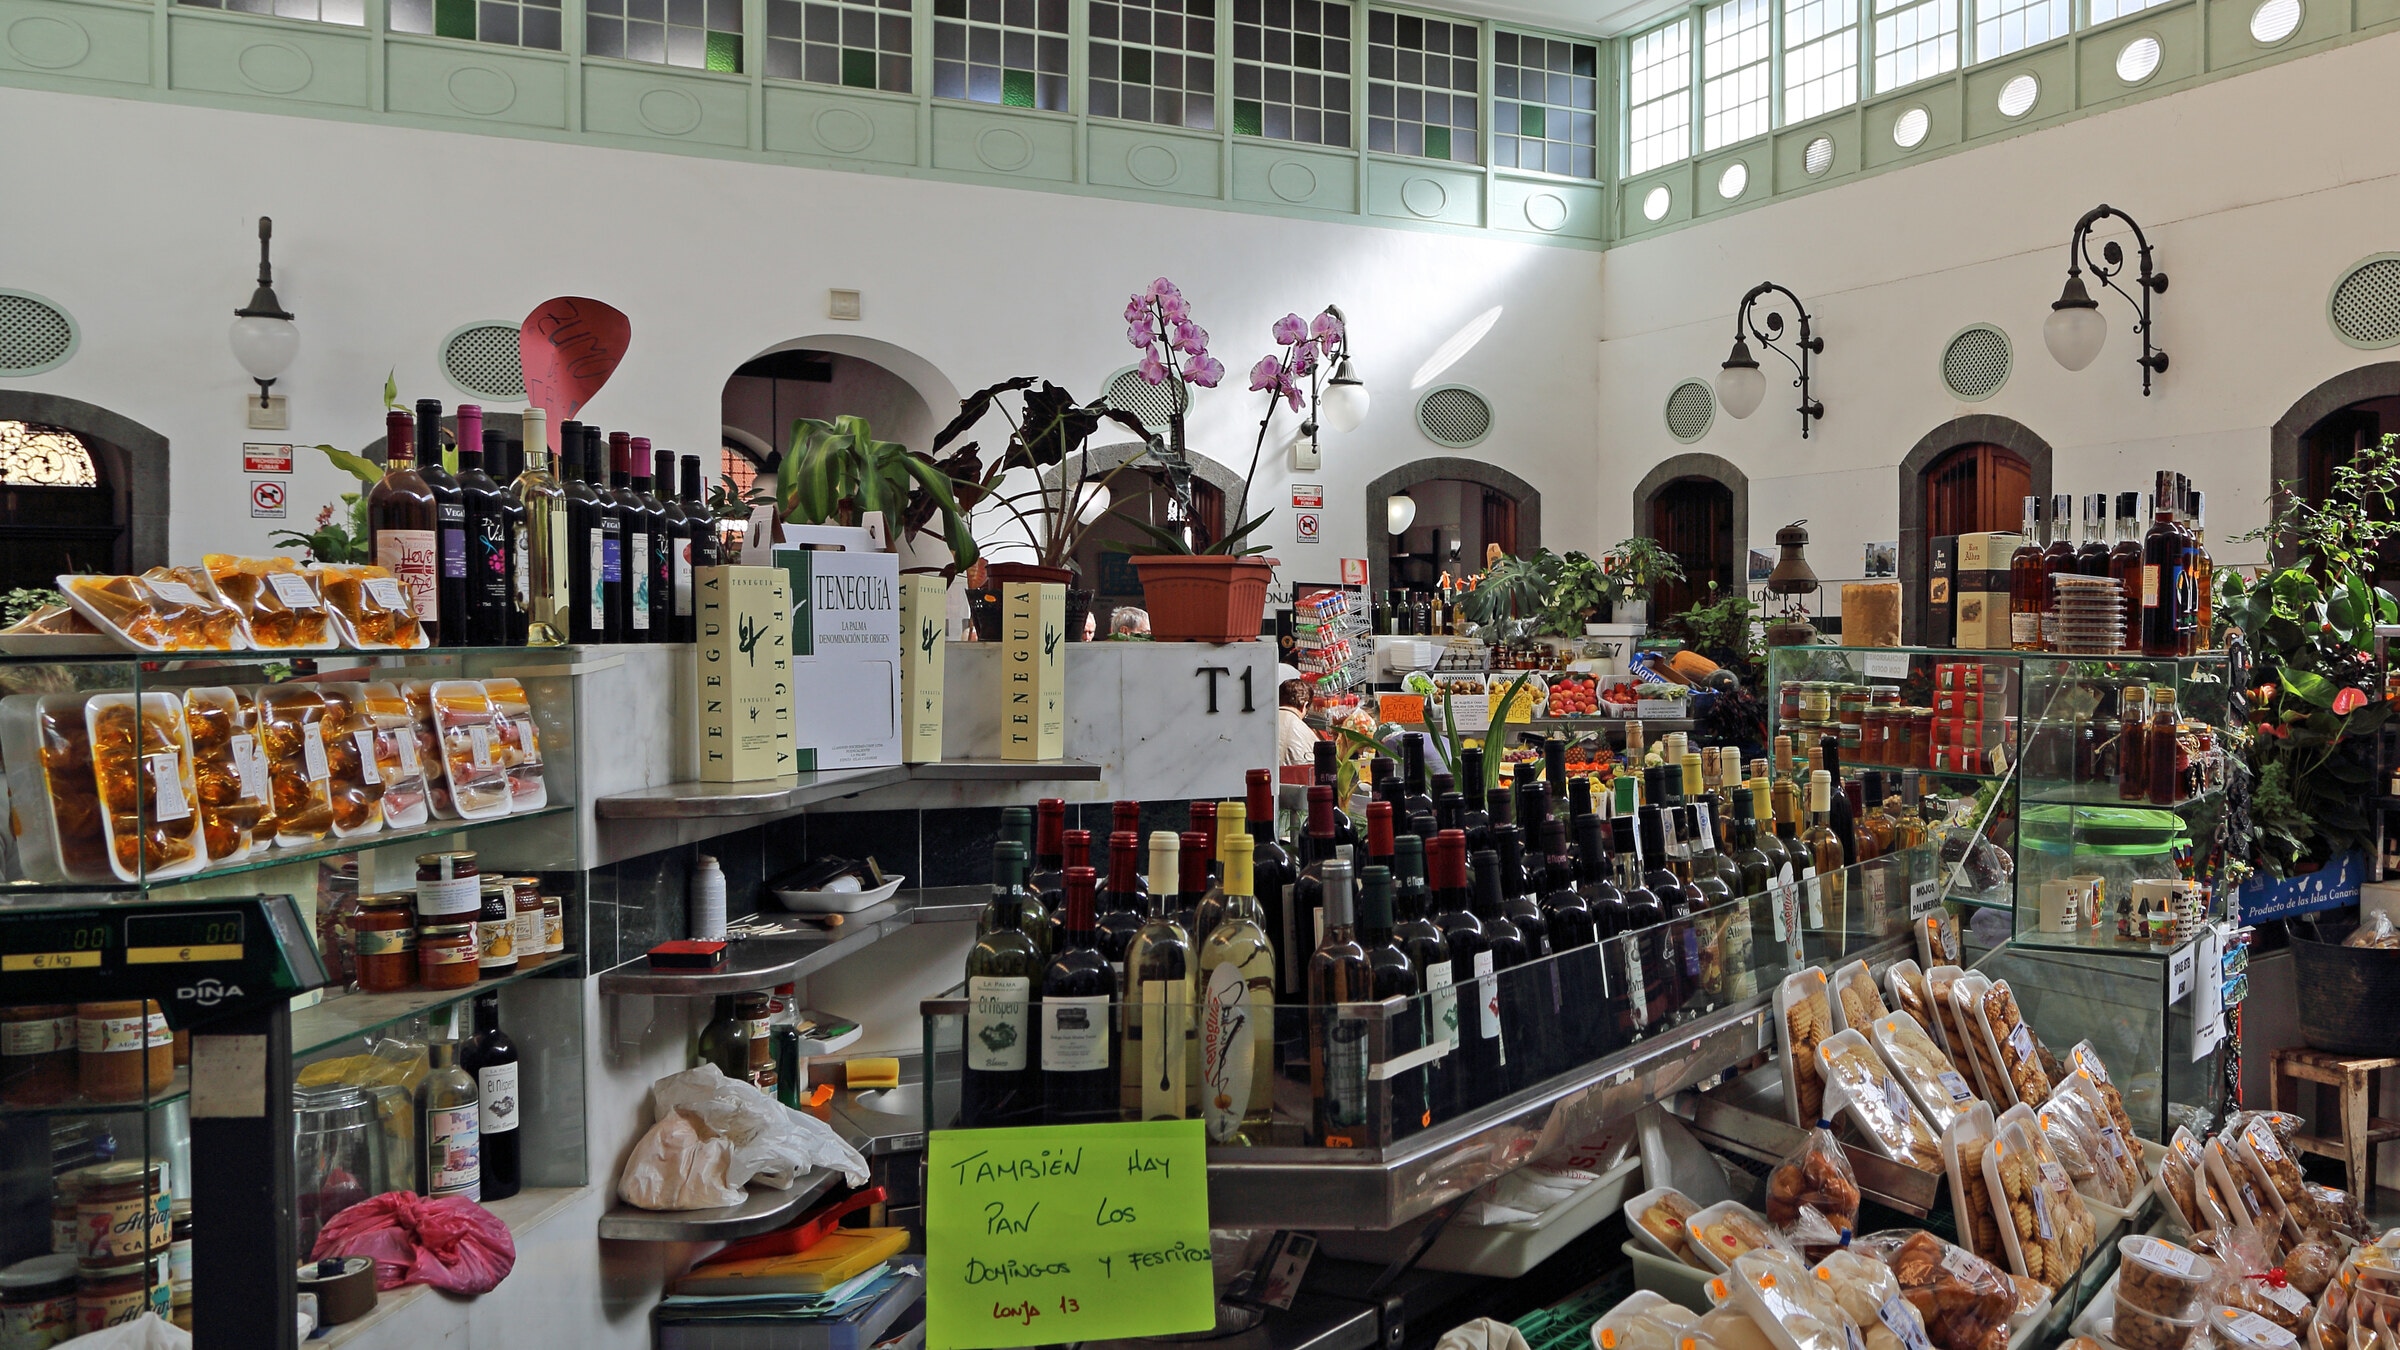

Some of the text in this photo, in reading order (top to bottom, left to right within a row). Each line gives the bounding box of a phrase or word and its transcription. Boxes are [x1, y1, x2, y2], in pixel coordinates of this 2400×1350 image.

[1264, 592, 1294, 604] ONJA
[841, 621, 867, 631] LA PALMA
[819, 633, 890, 644] DENOMINACIÓN DE ORIGEN
[705, 577, 723, 762] TENEGUIA
[1012, 592, 1030, 744] TENEGUIA
[1195, 665, 1256, 713] T1
[1381, 703, 1419, 713] VENDEN
[1916, 883, 1935, 897] MOJOS
[1912, 897, 1941, 915] PALMEROS
[2249, 903, 2285, 917] Producto
[2286, 901, 2297, 909] de
[2298, 897, 2309, 907] las
[2310, 893, 2328, 904] Islas
[179, 948, 191, 961] €
[951, 1146, 1170, 1186] TAMBIÉN HAY
[984, 1197, 1136, 1235] PAN LOS
[965, 1257, 1071, 1285] DOMINGOS
[1098, 1255, 1112, 1279] Y
[1059, 1296, 1080, 1314] 13
